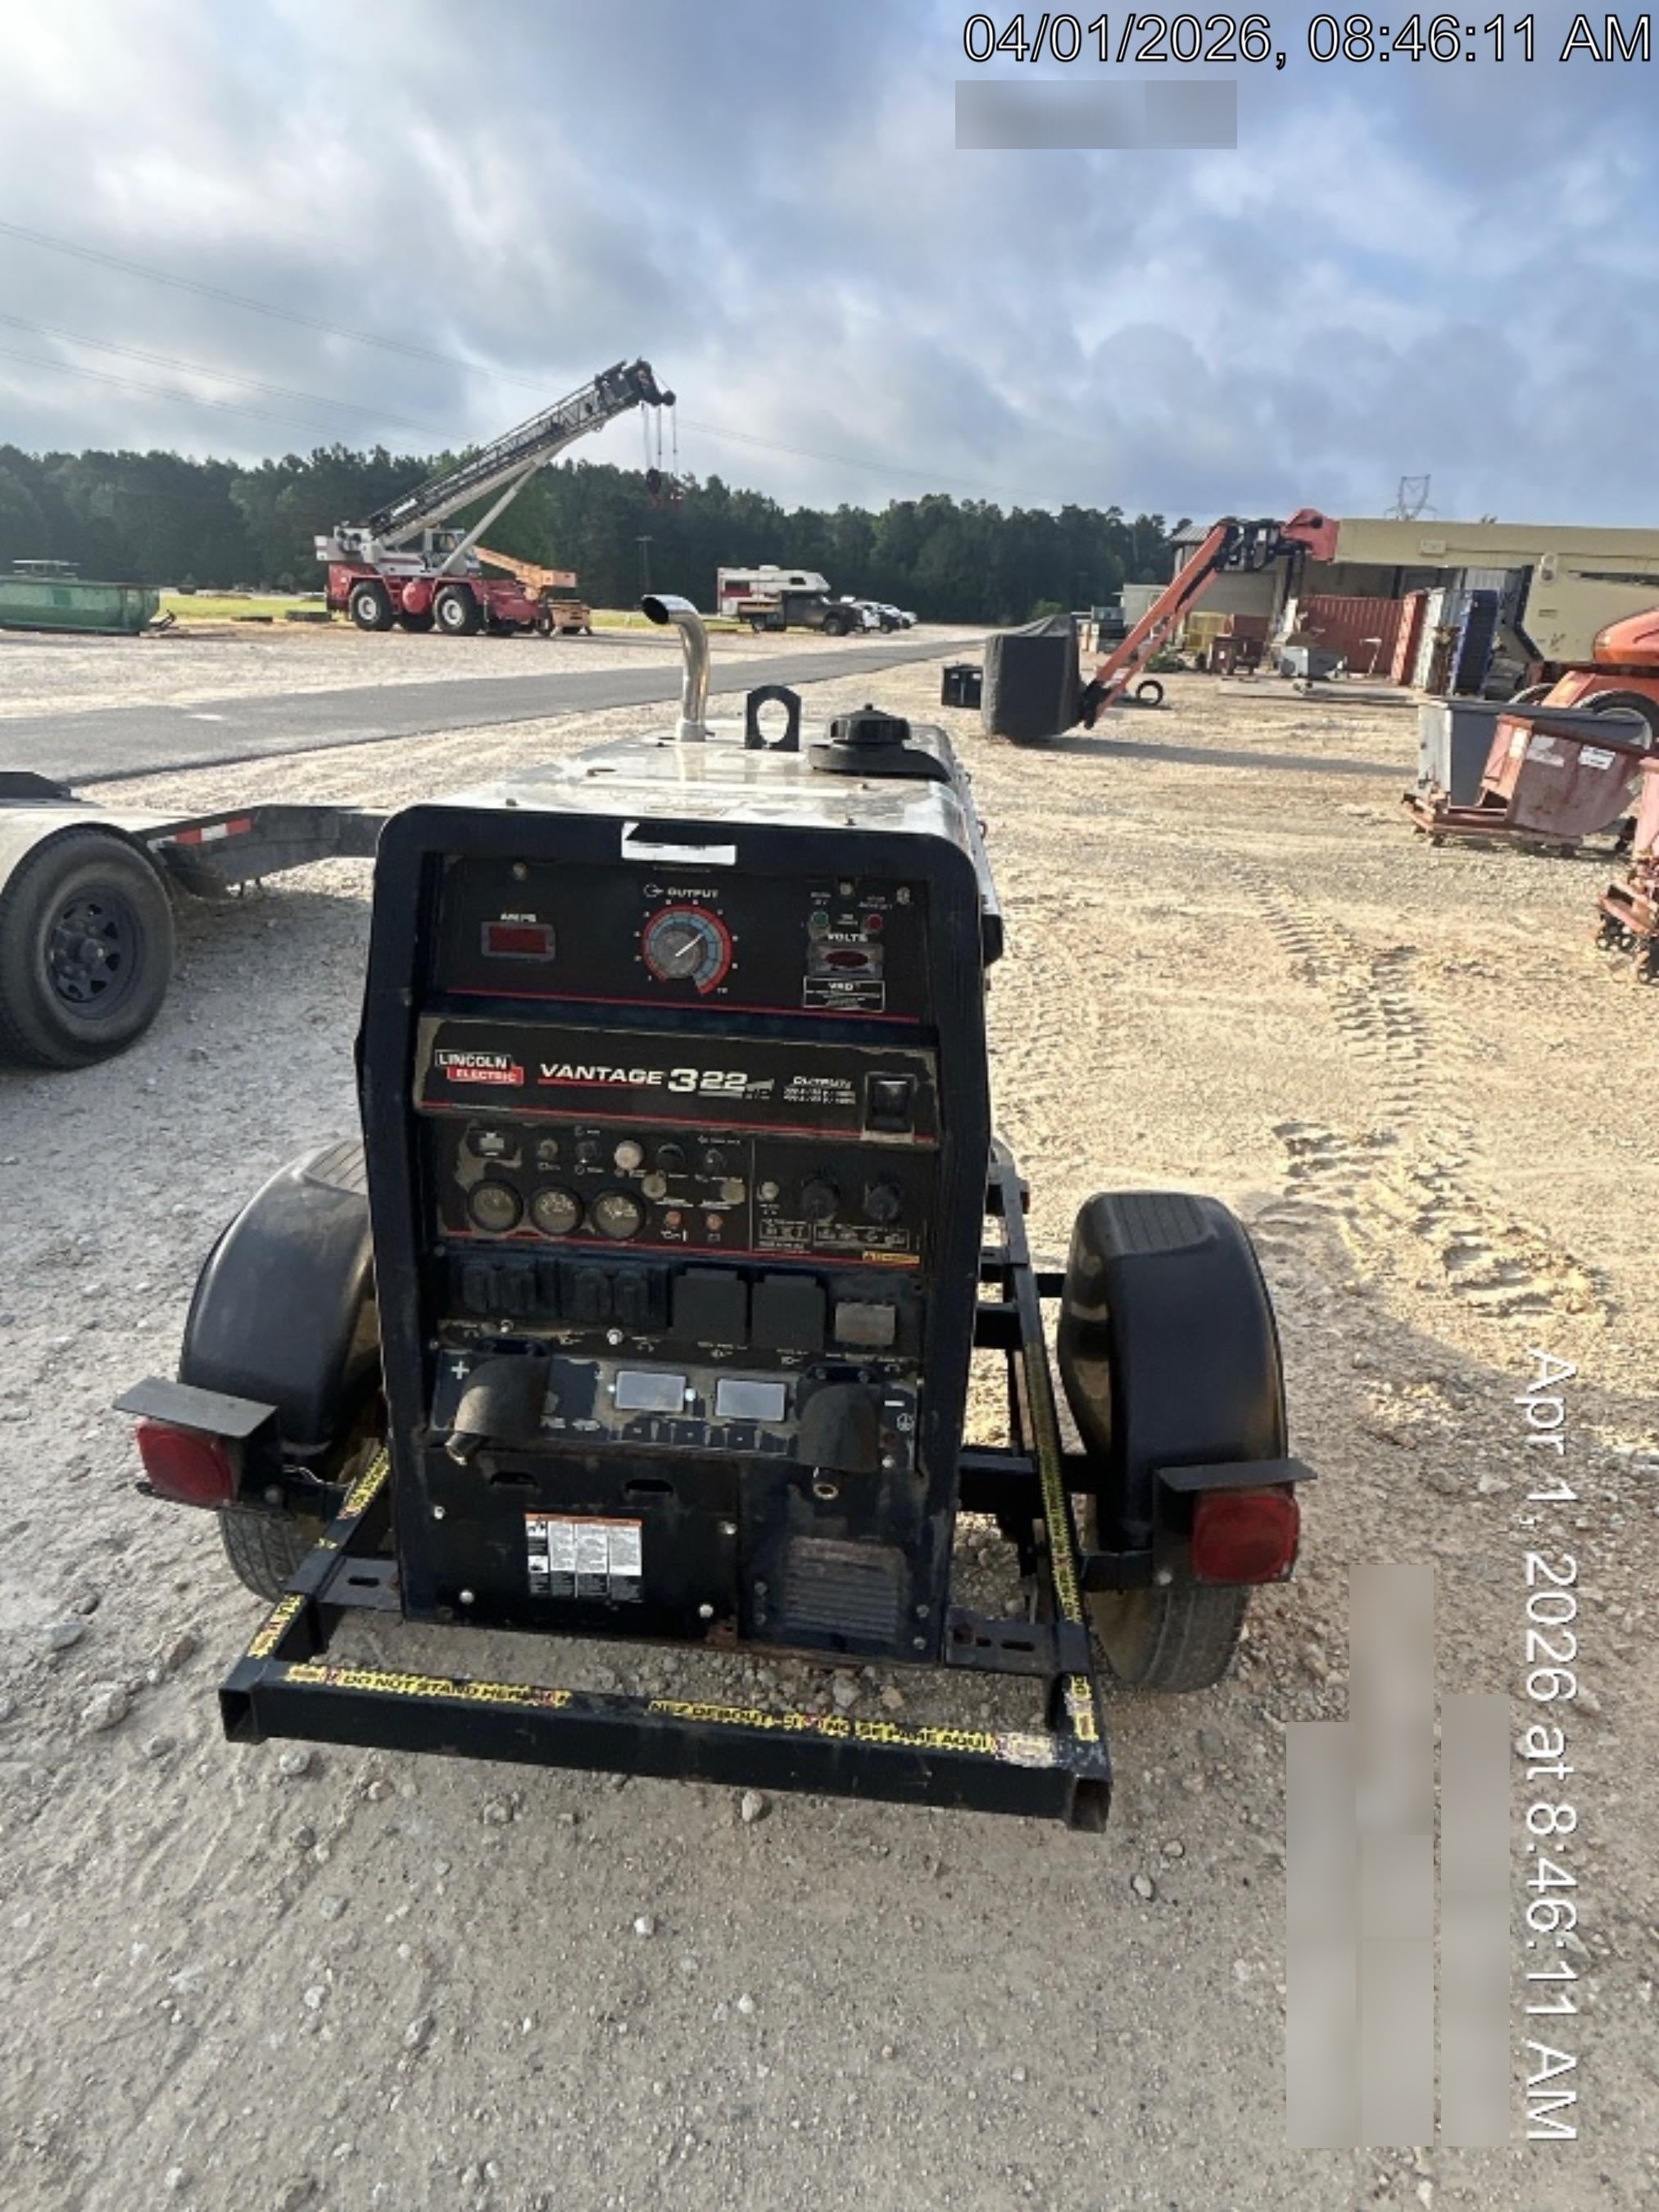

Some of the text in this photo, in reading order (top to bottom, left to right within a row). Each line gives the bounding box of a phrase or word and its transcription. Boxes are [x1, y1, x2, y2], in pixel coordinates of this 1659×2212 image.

[667, 887, 718, 898] OUTPUT
[438, 1053, 508, 1070] LINCOLN
[456, 1068, 518, 1082] ELECTRIC
[540, 1063, 749, 1093] VANTAGE 322
[374, 1678, 415, 1691] NOT
